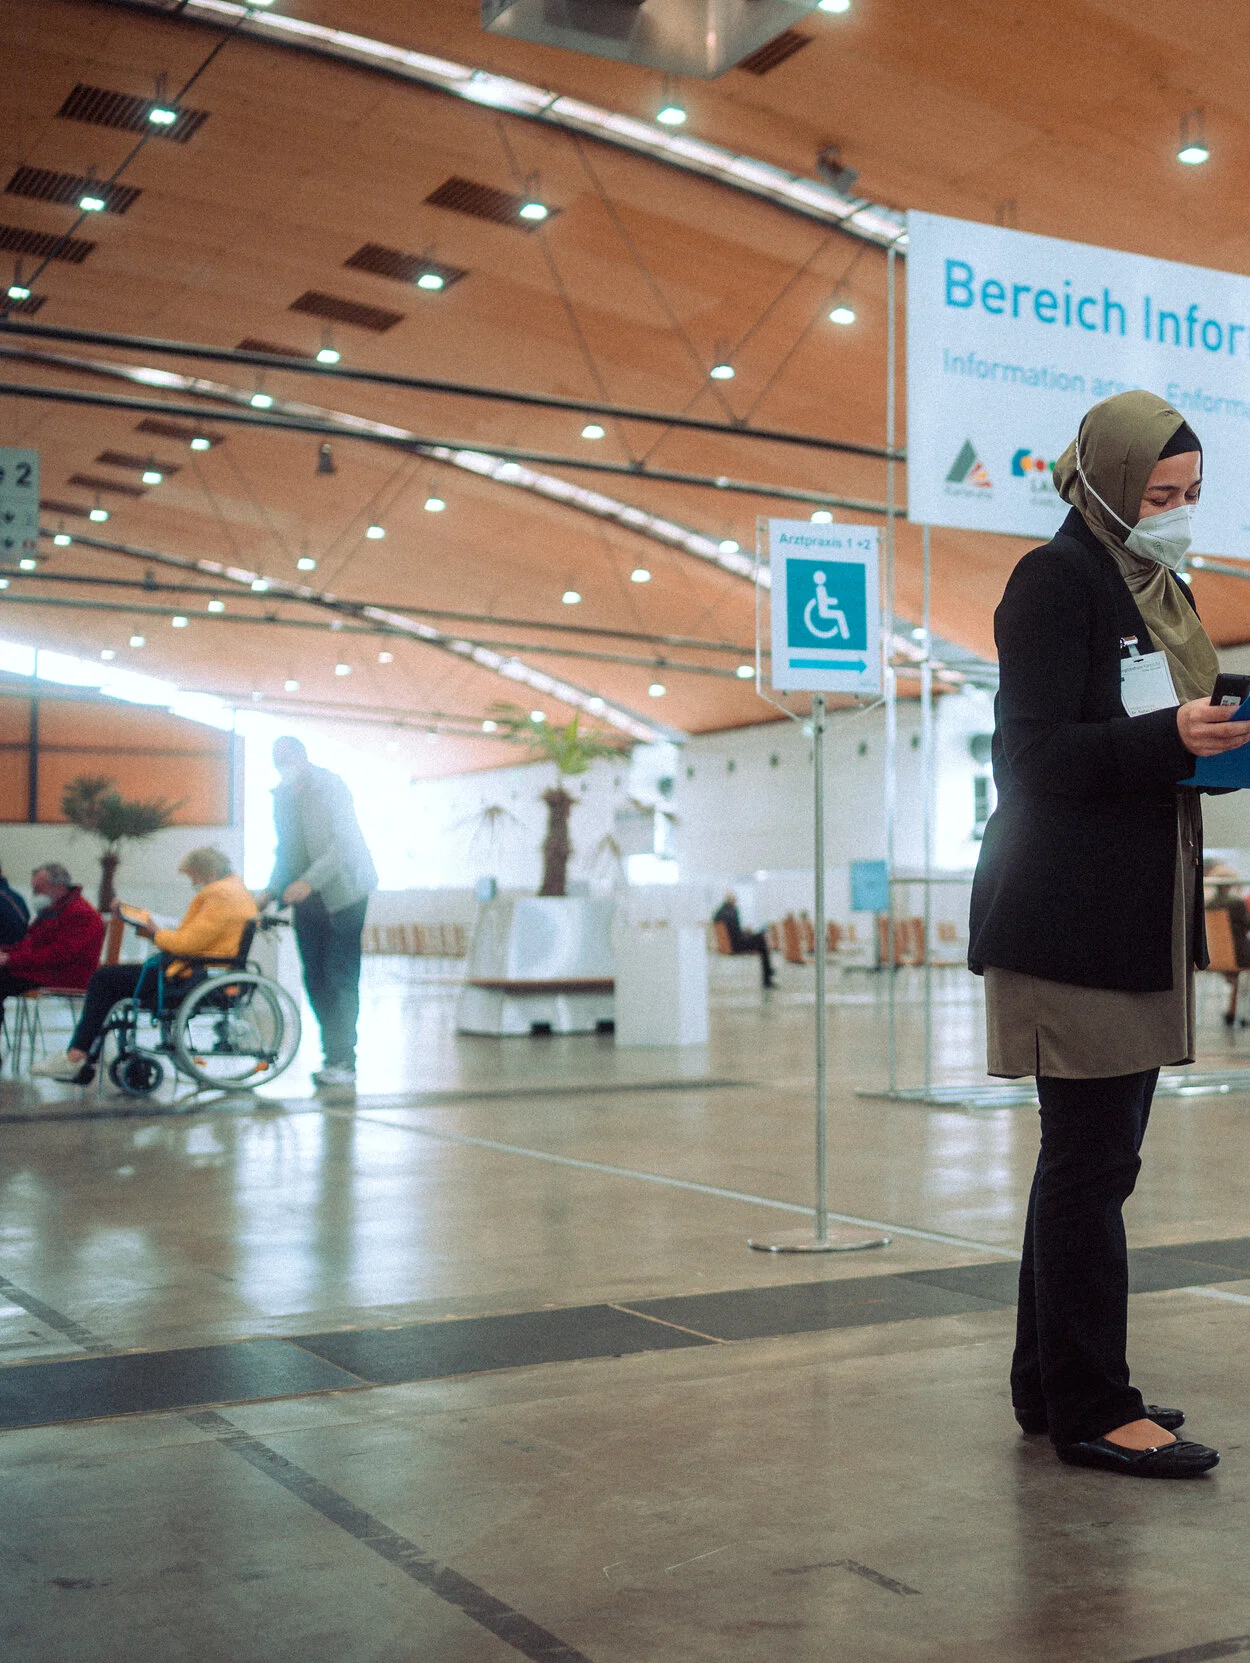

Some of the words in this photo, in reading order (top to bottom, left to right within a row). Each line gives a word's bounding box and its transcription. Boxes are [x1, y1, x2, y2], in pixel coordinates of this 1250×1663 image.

[945, 258, 1126, 336] Bereich
[943, 348, 1086, 393] Information
[1091, 377, 1141, 398] are
[779, 533, 842, 549] Arztpraxis
